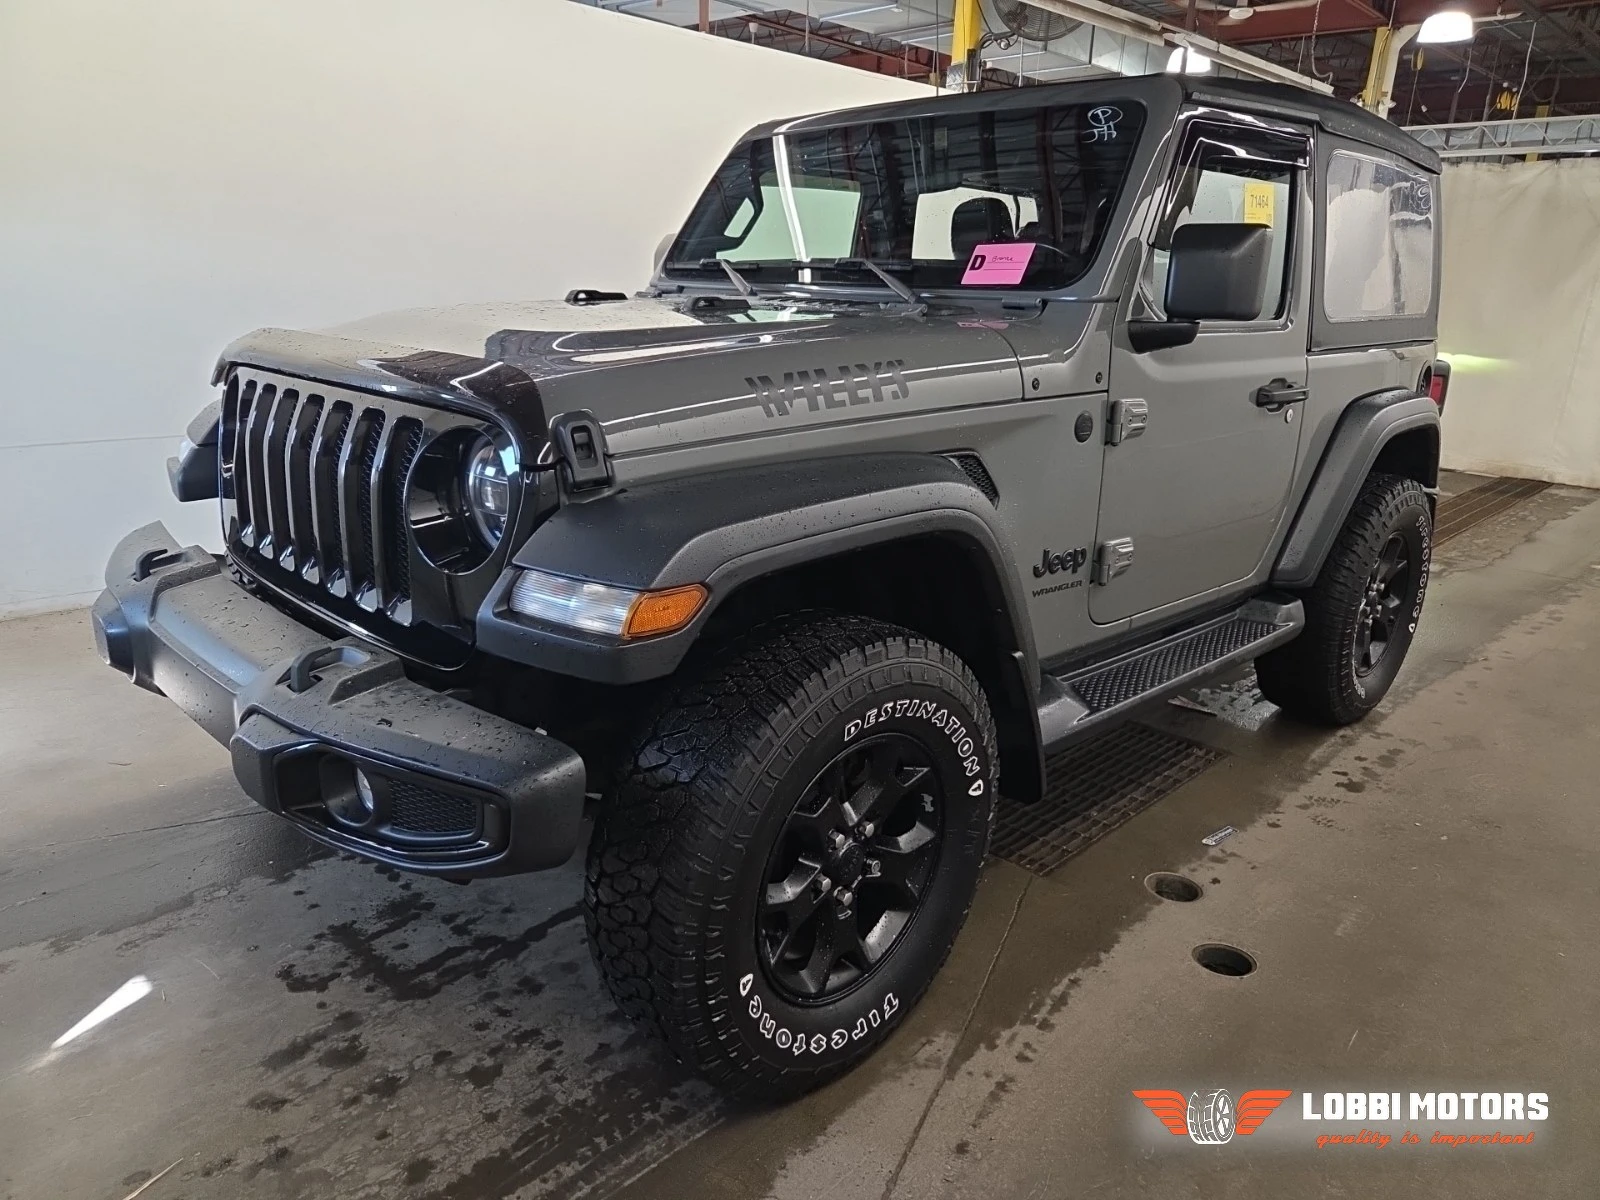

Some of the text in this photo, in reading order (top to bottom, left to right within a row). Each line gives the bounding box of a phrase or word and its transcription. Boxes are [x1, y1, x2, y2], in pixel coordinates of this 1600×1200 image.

[1250, 194, 1269, 209] 71464
[969, 254, 987, 271] D
[744, 359, 909, 418] WILLYS
[1033, 547, 1087, 578] Jeep
[1032, 580, 1083, 598] WRANGLER
[844, 699, 981, 777] DESTINATION
[749, 992, 899, 1056] Firestone
